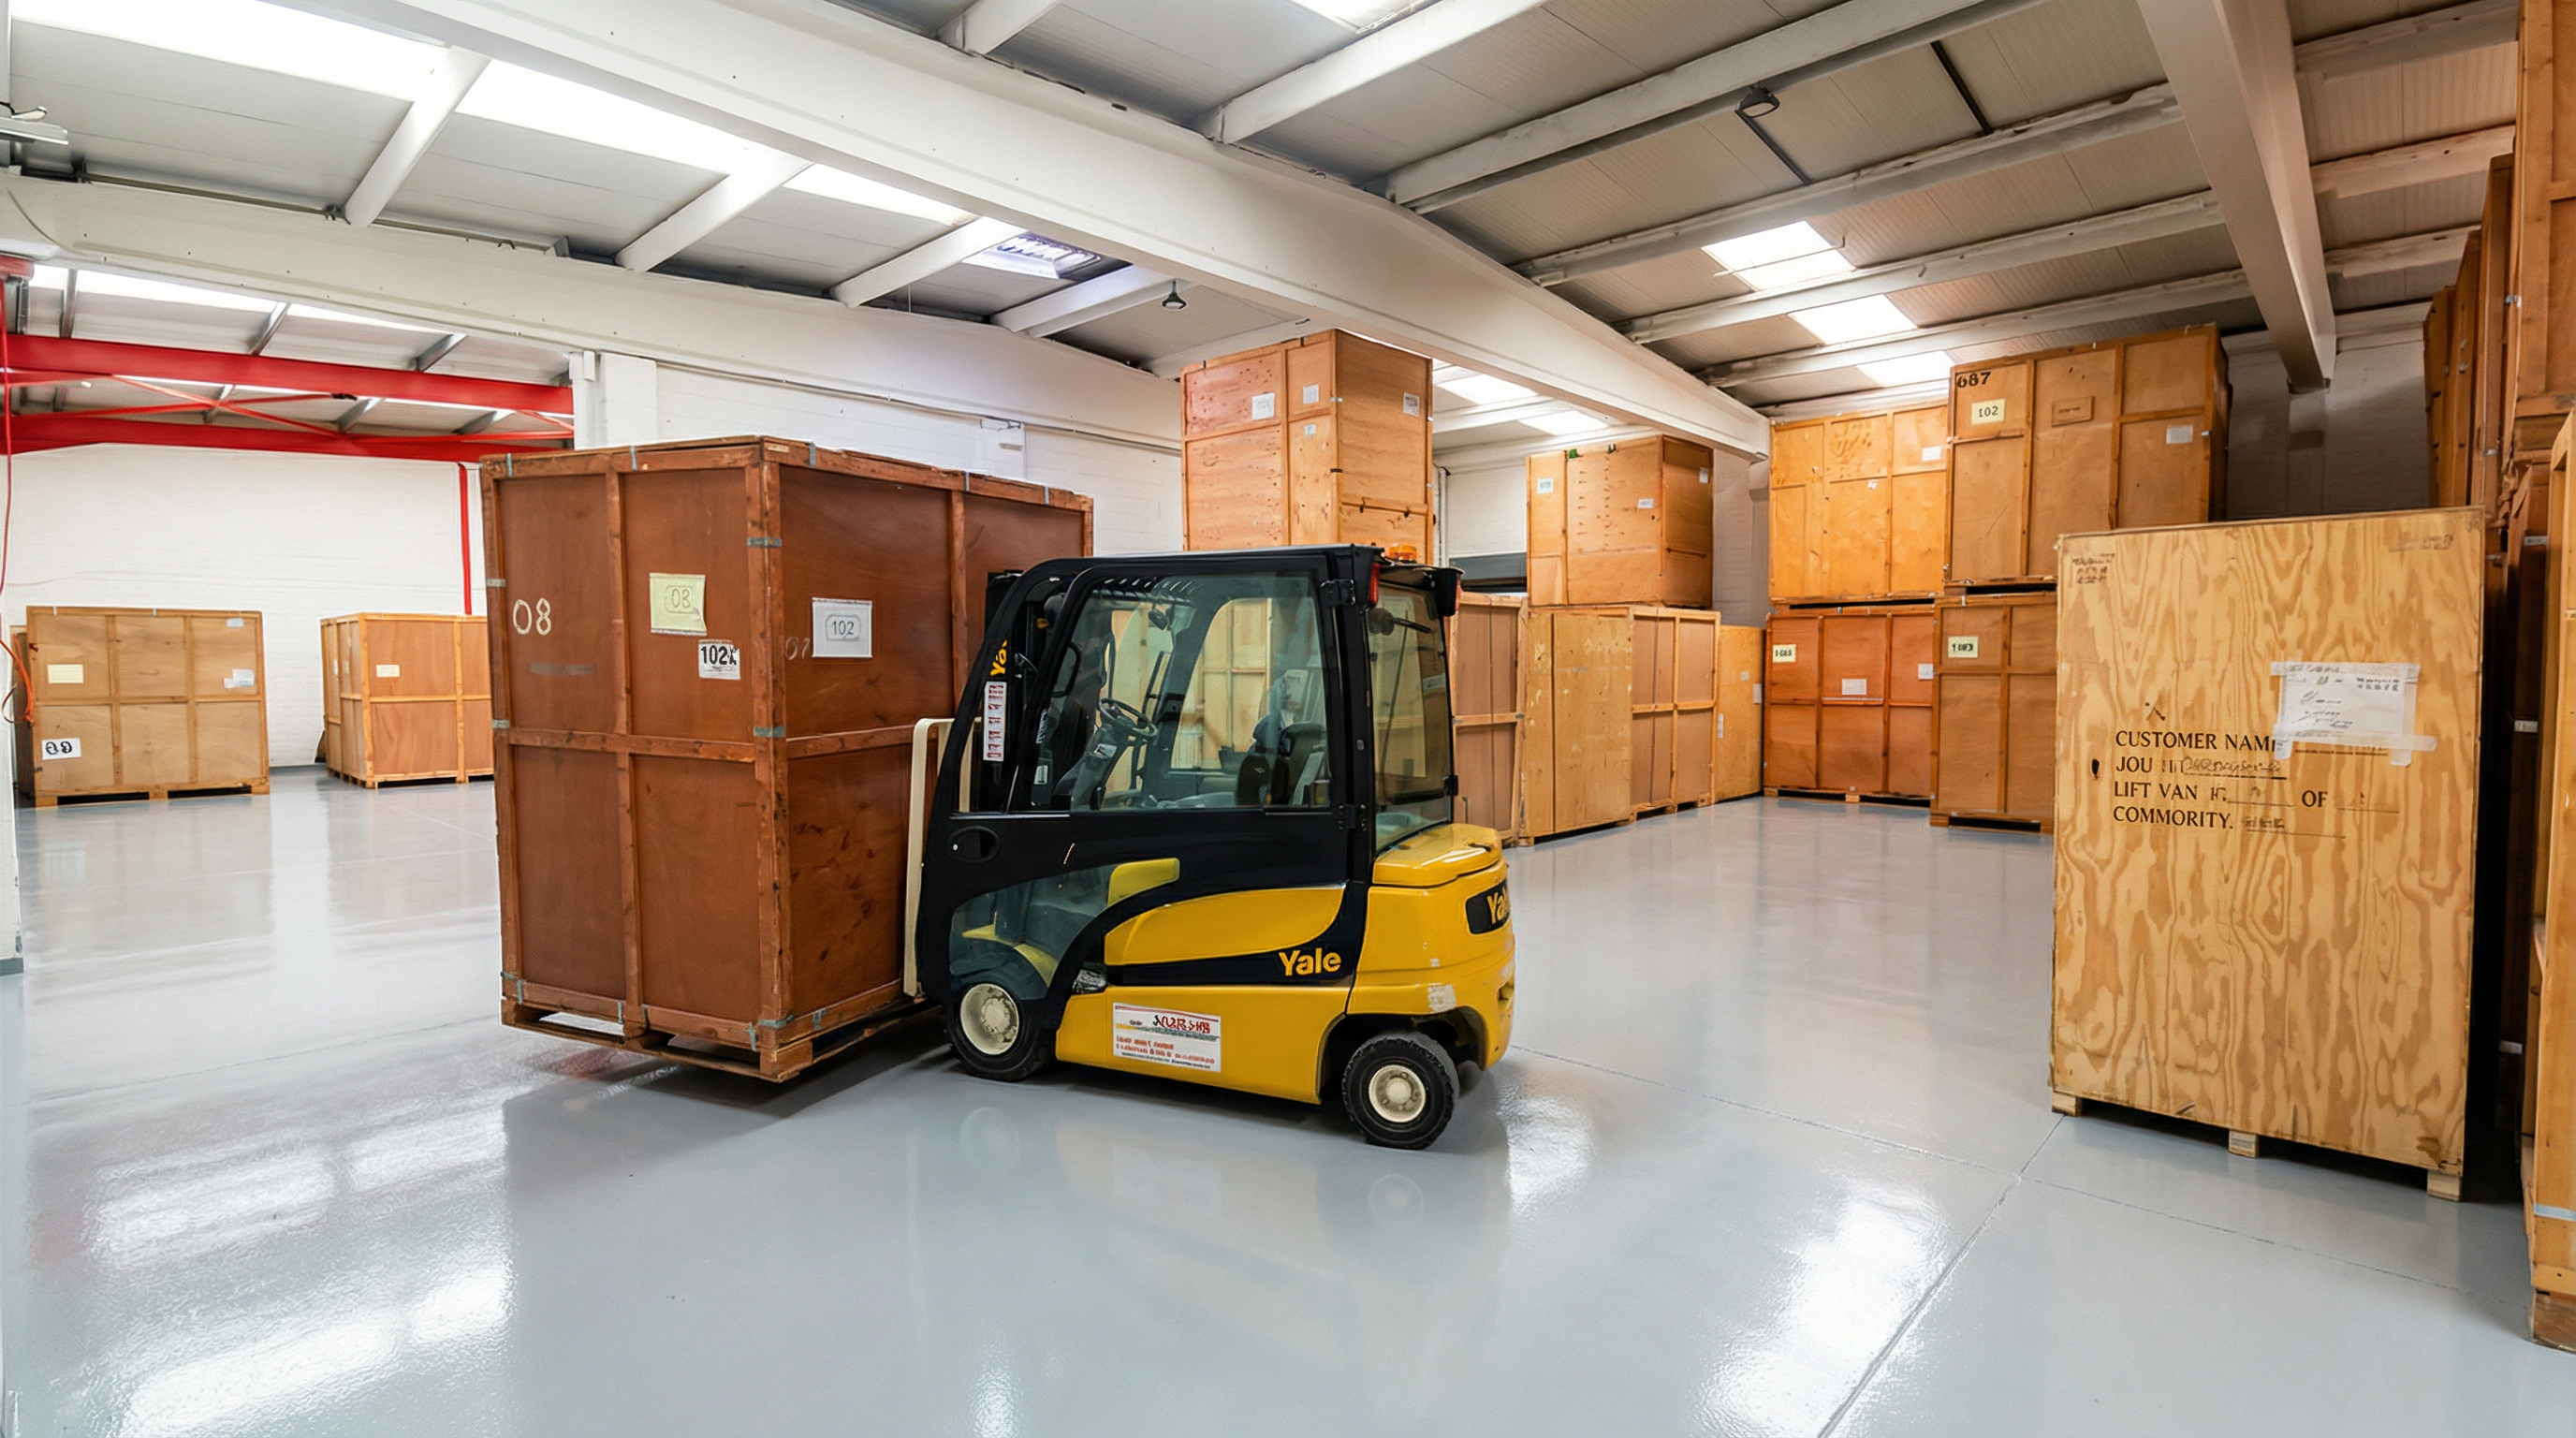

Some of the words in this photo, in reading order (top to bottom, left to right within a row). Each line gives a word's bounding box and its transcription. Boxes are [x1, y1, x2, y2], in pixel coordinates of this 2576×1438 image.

[1956, 371, 1992, 389] 687
[1978, 405, 1998, 418] 102
[512, 597, 552, 636] 08
[830, 620, 855, 636] 102
[989, 639, 1008, 677] Ya
[2115, 730, 2217, 750] CUSTOMER
[2115, 756, 2153, 773] JOU
[2114, 781, 2152, 799] LIFT
[2159, 783, 2198, 800] VAN
[2301, 789, 2328, 808] OF
[2113, 805, 2233, 829] COMMORITY.
[1279, 947, 1341, 976] Yale
